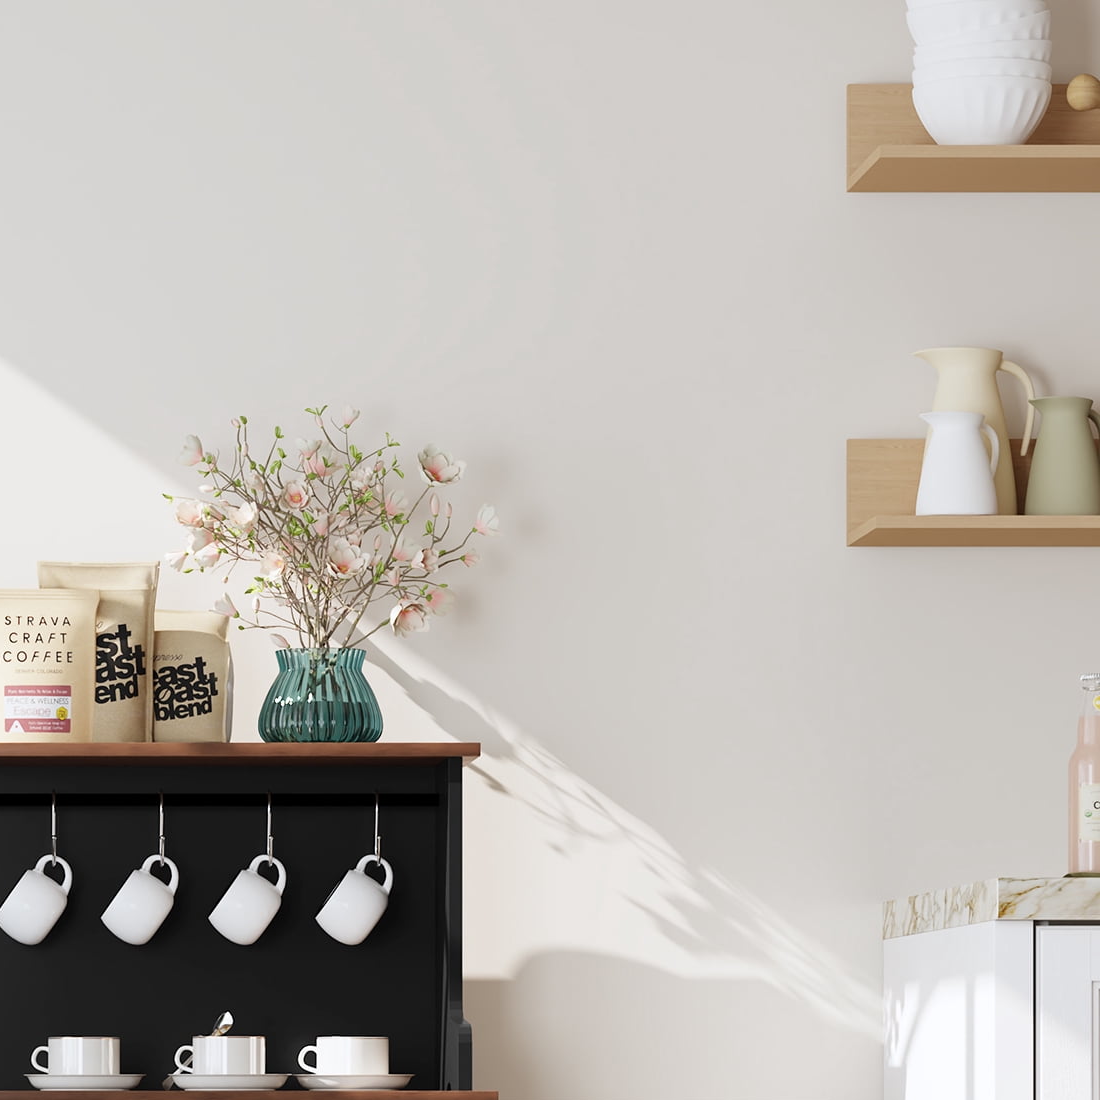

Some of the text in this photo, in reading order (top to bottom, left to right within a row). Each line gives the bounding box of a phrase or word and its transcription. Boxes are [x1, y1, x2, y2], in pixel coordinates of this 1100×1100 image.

[4, 616, 71, 626] STRAVA
[9, 632, 67, 644] CRAFT
[96, 624, 132, 657] st
[2, 651, 73, 663] COFFEE
[95, 673, 139, 704] end
